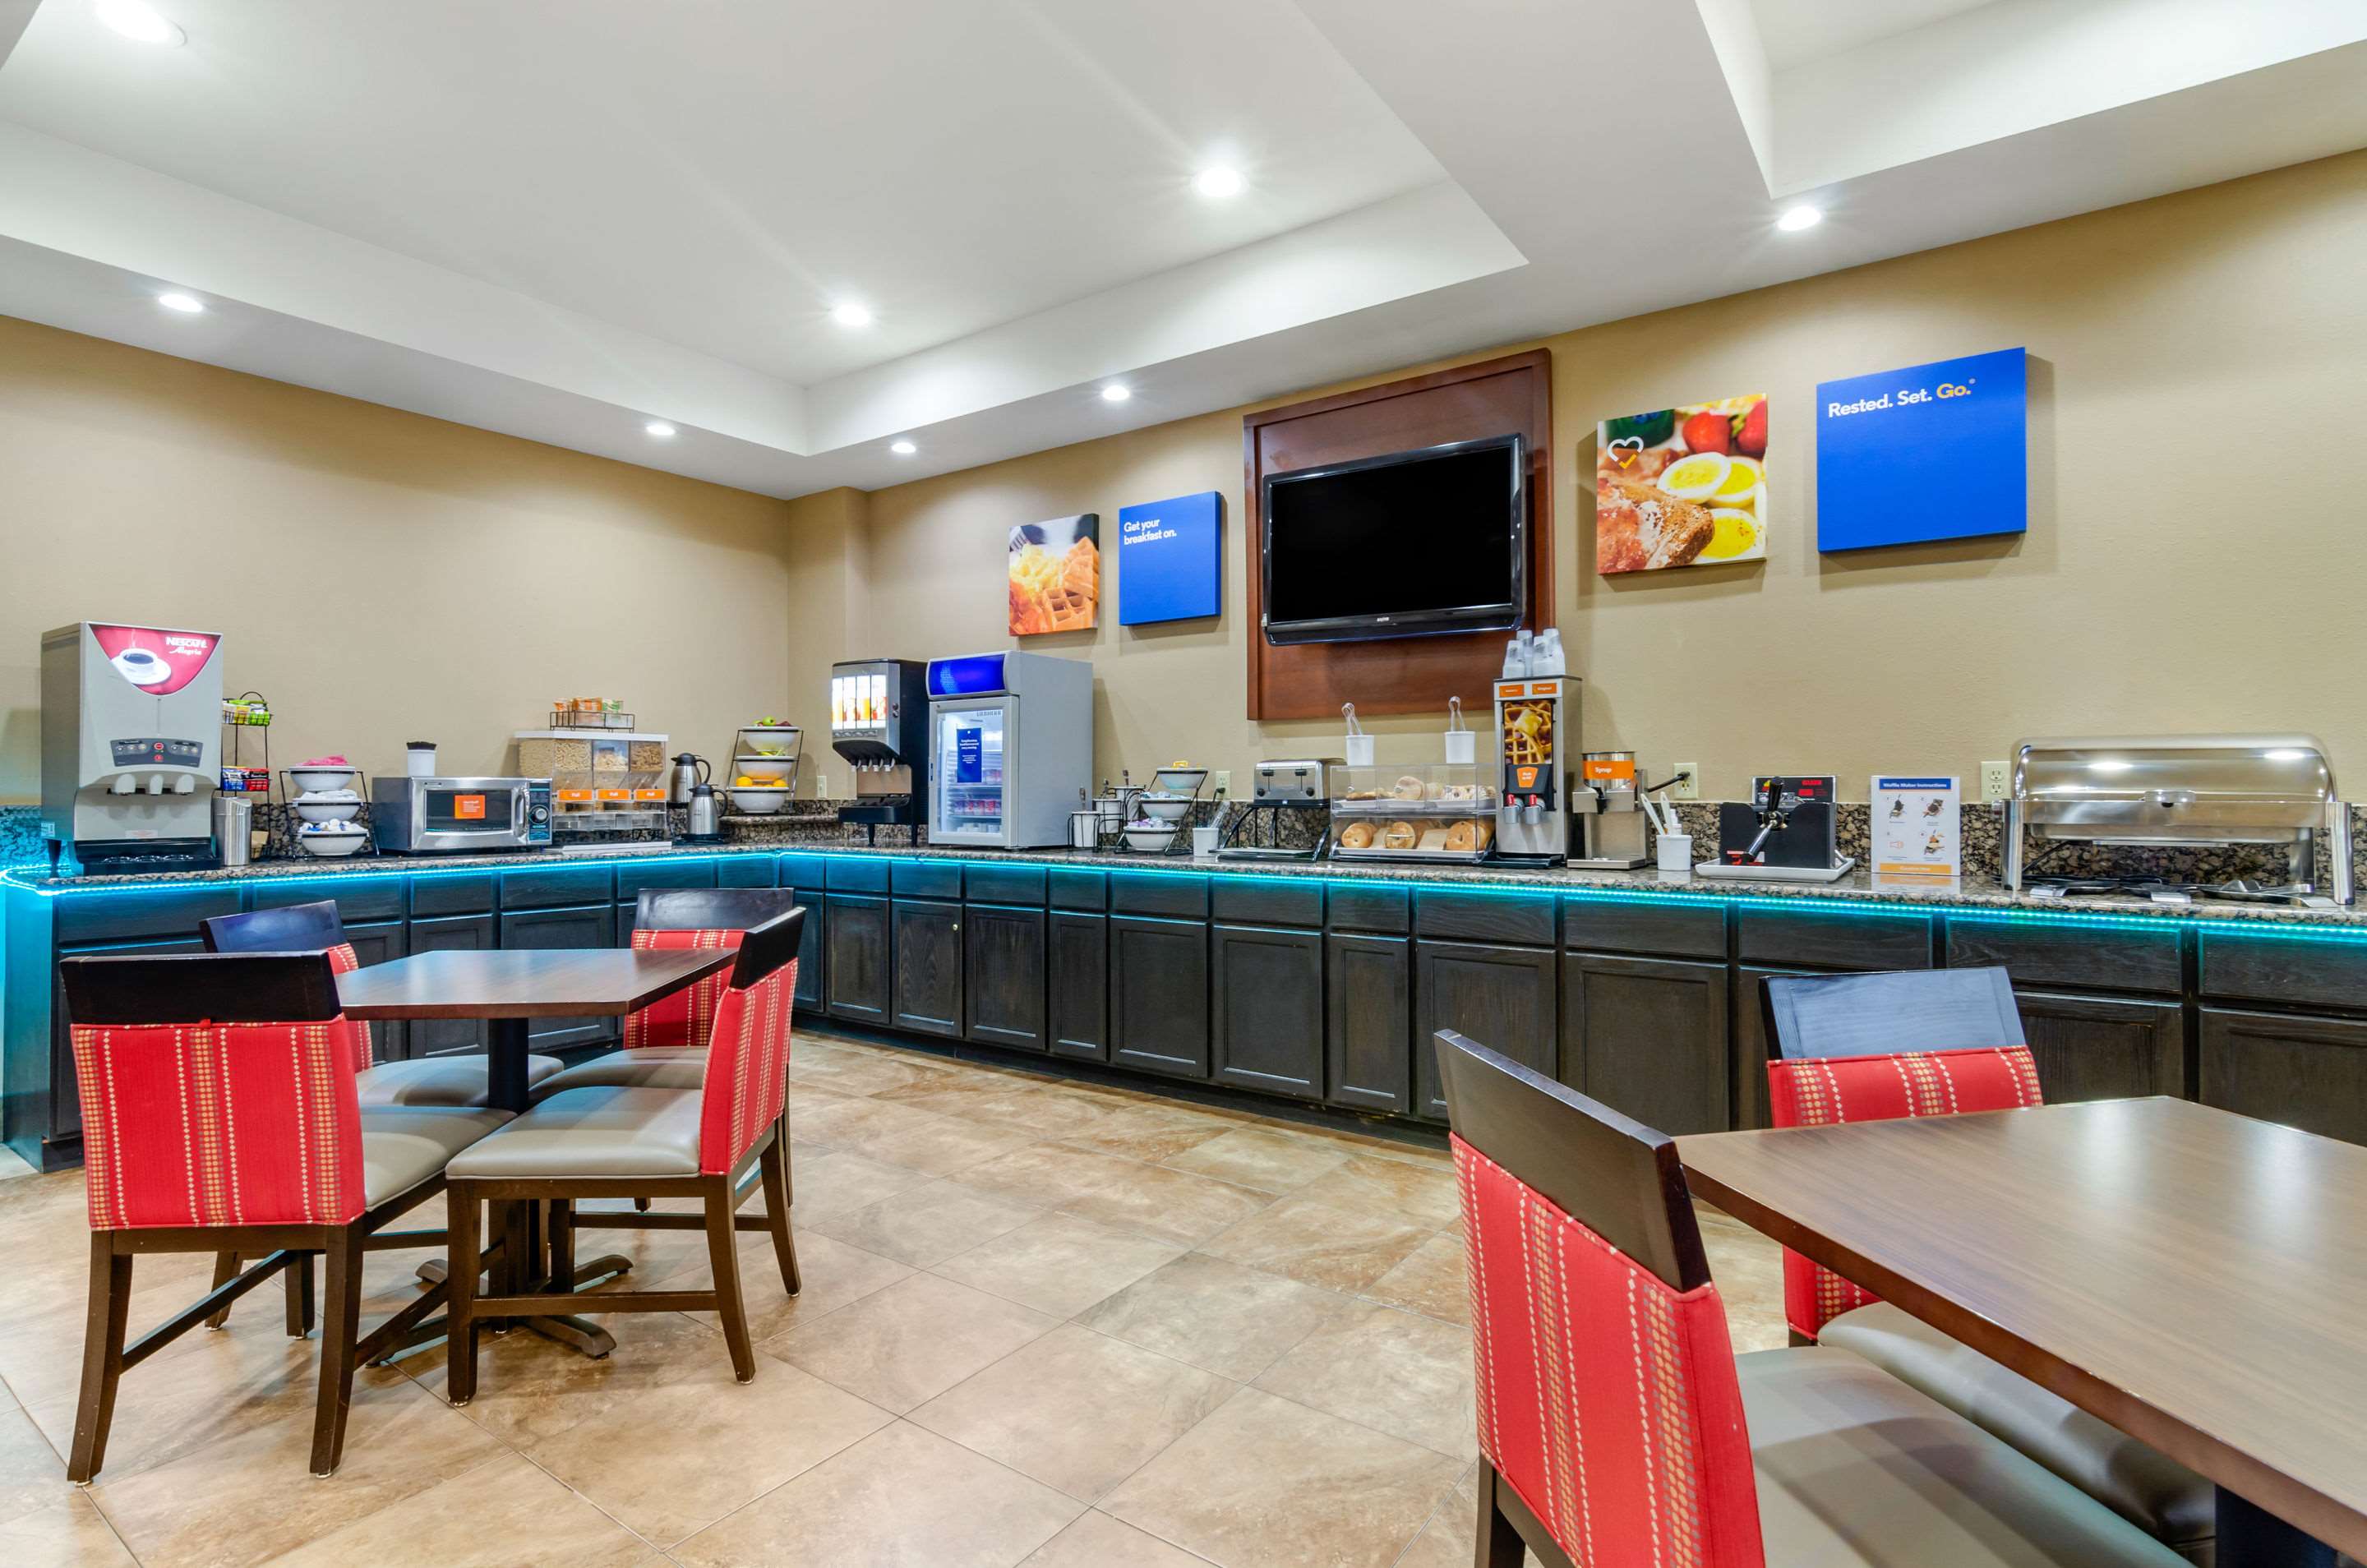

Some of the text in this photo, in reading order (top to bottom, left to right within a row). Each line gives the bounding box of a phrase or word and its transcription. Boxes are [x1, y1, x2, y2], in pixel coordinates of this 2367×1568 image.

[1828, 394, 1894, 418] Rested.
[1897, 388, 1933, 406] Set.
[1124, 519, 1160, 532] Get your
[1124, 529, 1177, 545] breakfast on.
[1594, 766, 1613, 774] Syrup
